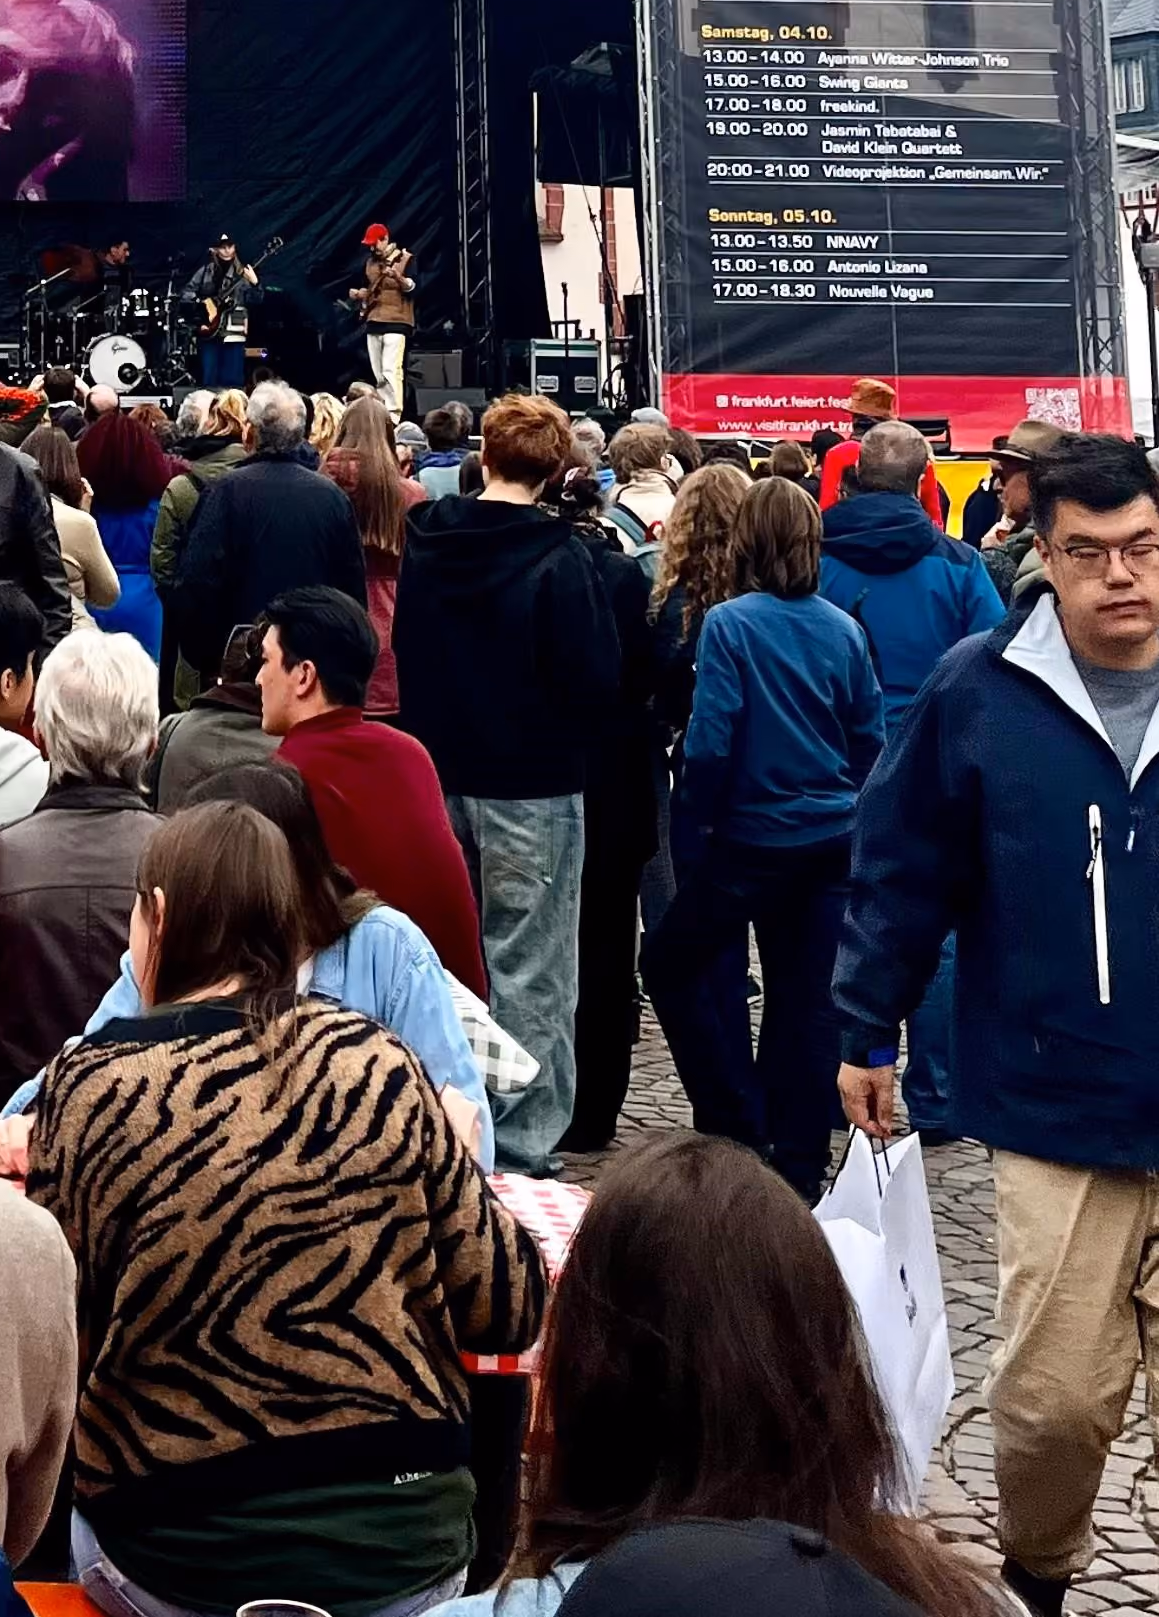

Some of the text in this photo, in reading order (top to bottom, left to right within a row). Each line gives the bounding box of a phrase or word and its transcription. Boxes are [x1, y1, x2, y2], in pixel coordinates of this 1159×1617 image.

[701, 25, 832, 42] Samstag, 04.10.
[818, 52, 868, 67] Ayanna
[872, 52, 979, 67] Witter-Johnson
[982, 54, 1009, 67] Trio
[818, 75, 860, 92] Swing
[864, 76, 908, 89] Giants
[820, 99, 880, 113] freekind.
[821, 123, 870, 137] Jasmin
[875, 124, 940, 137] Tabatabai
[945, 125, 957, 138] &
[822, 141, 963, 155] David Klein Quartett
[823, 164, 925, 181] Videoprojektion
[708, 209, 837, 225] Sonntag, 05.10.
[826, 236, 879, 249] NNAVY
[827, 260, 881, 273] Antonio
[885, 260, 928, 273] Lizana
[829, 284, 887, 298] Nouvelle
[891, 285, 934, 301] Vague
